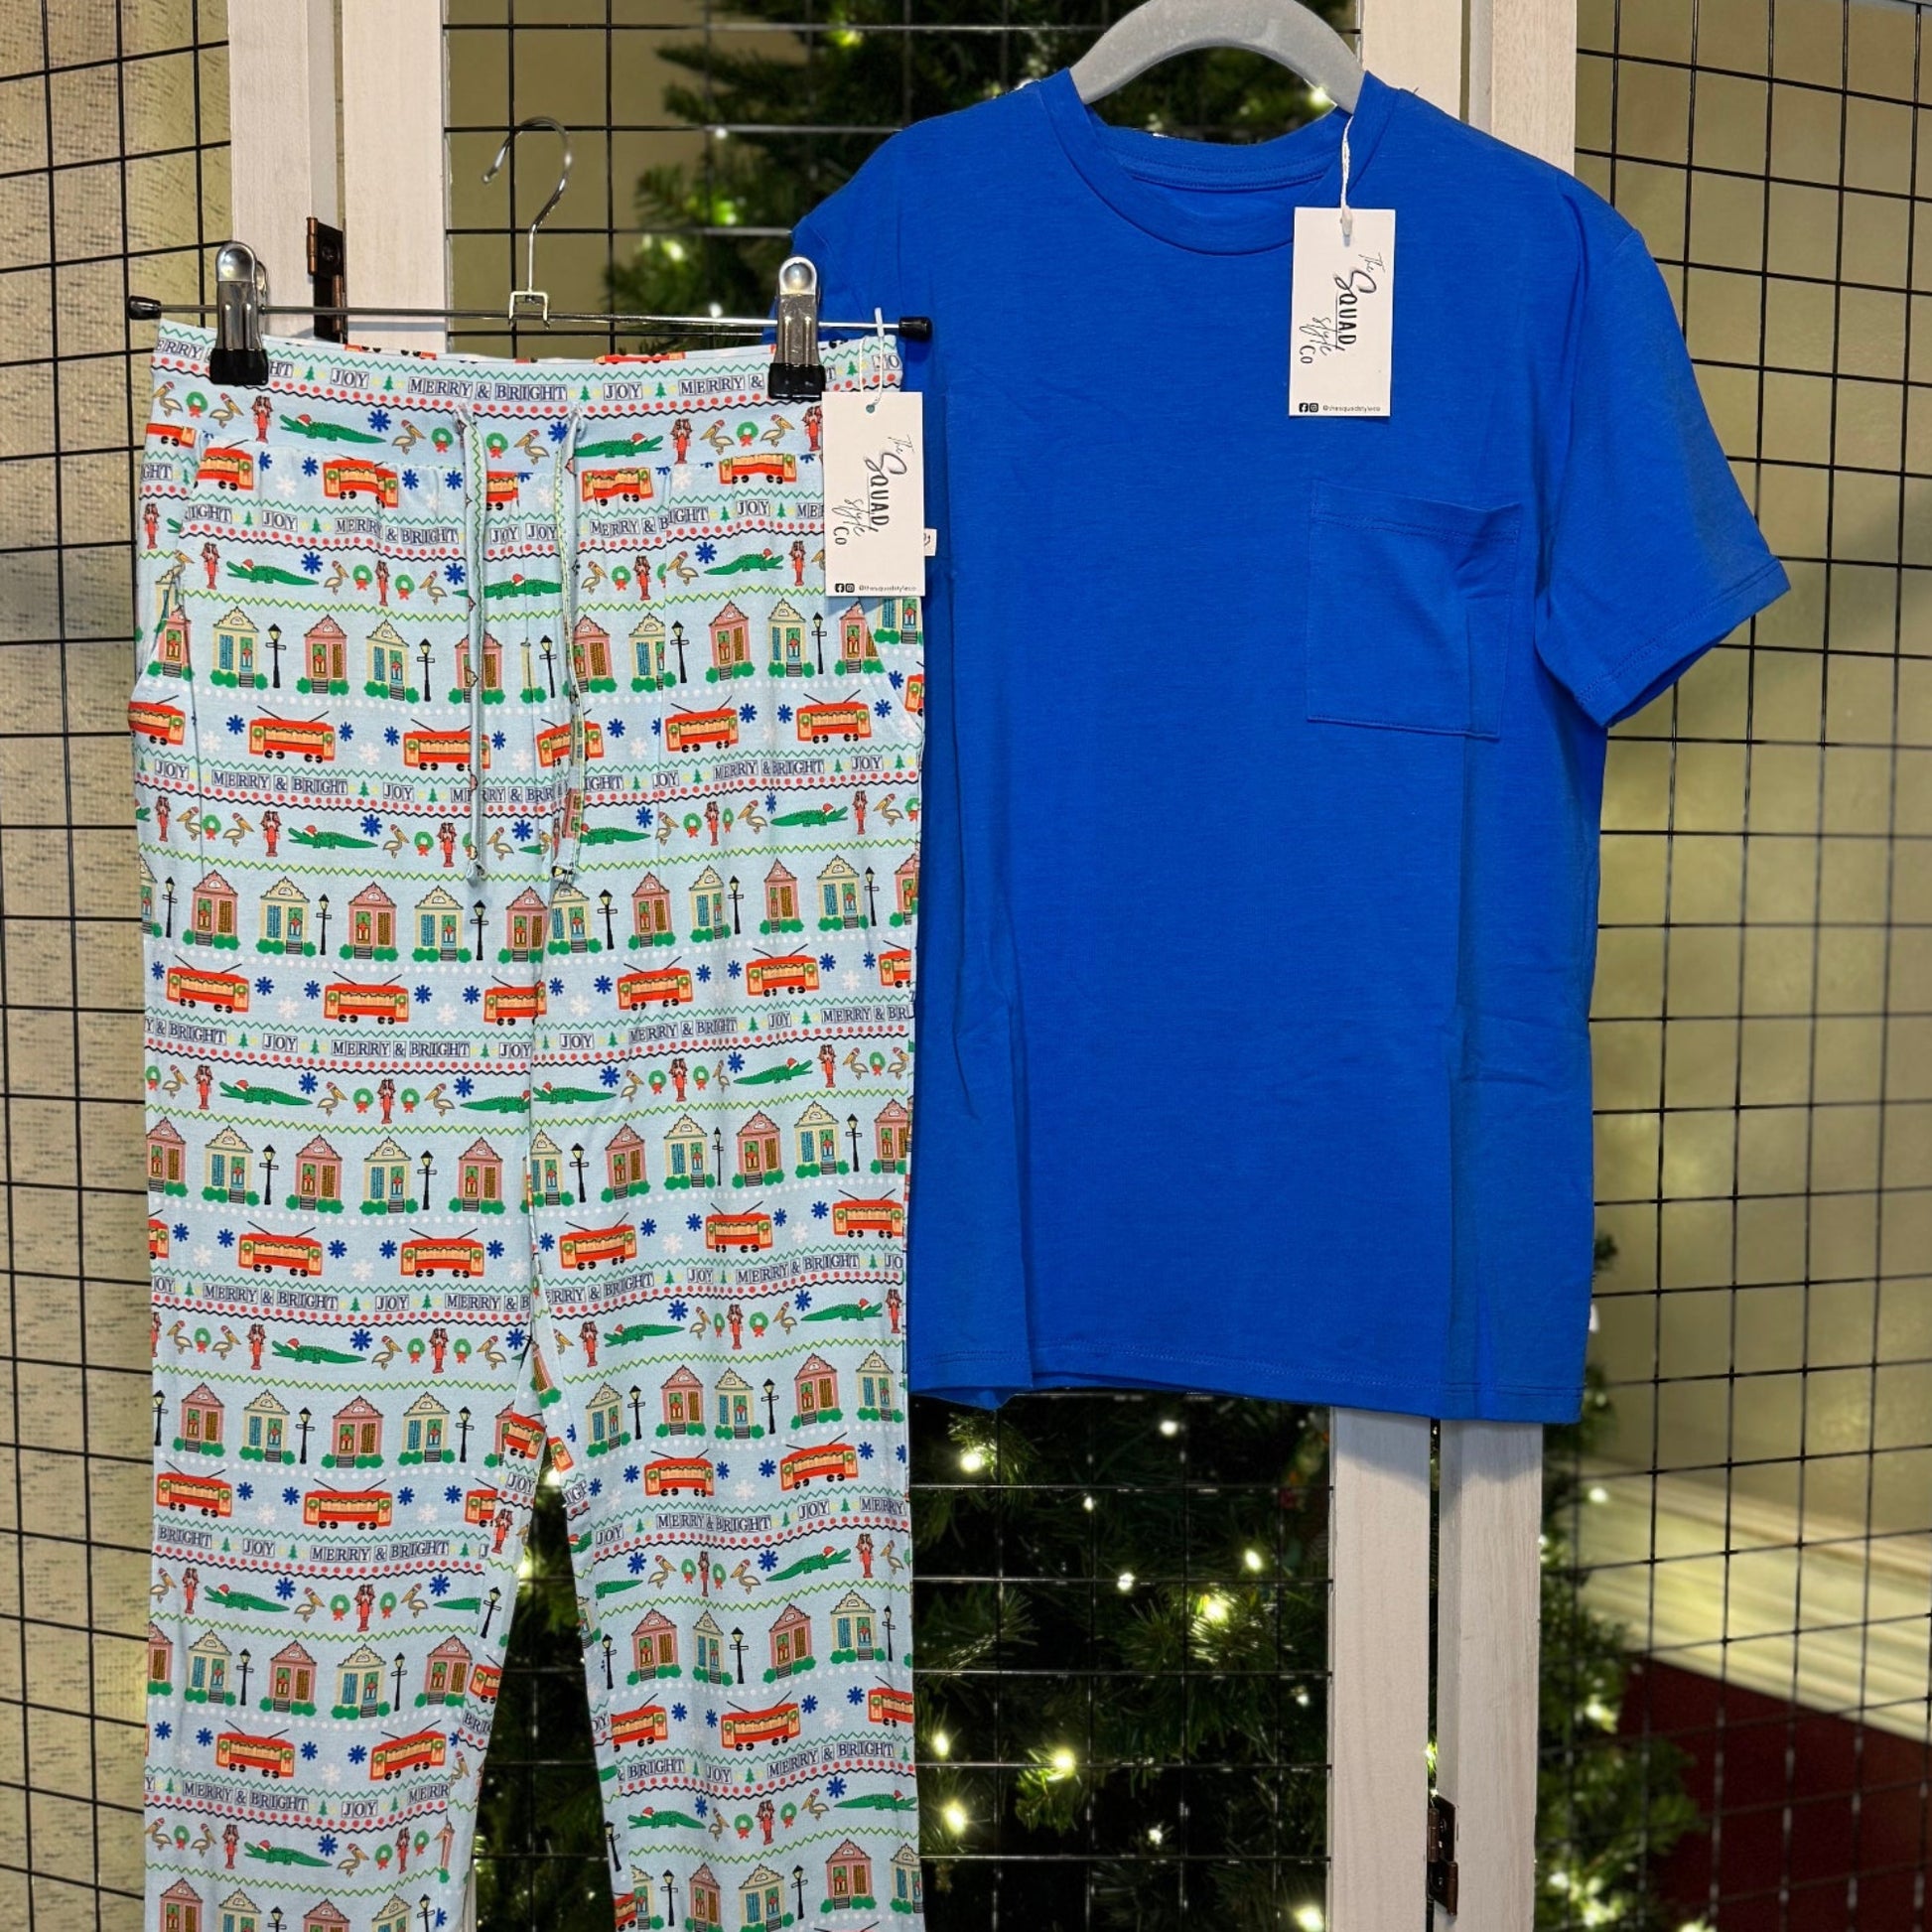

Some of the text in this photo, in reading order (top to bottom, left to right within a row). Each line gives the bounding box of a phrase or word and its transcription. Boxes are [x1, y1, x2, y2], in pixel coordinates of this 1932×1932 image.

[1358, 252, 1386, 272] The
[1299, 345, 1315, 364] Co
[332, 369, 368, 388] JOY
[679, 373, 763, 395] MERRY &
[409, 378, 567, 401] MERRY & BRIGHT
[605, 383, 642, 400] JOY
[888, 434, 914, 454] The
[737, 498, 770, 515] JOY
[263, 511, 297, 531] JOY
[642, 518, 655, 533] &
[385, 526, 398, 542] &
[833, 526, 848, 546] Co
[155, 760, 189, 780] JOY
[714, 759, 758, 780] MERRY
[851, 755, 883, 771] JOY
[211, 770, 347, 795] MERRY & BRIGHT
[383, 784, 414, 801] JOY
[508, 785, 522, 802] &
[767, 1012, 791, 1029] JOY
[822, 1006, 872, 1024] MERRY
[873, 1006, 885, 1021] &
[155, 1022, 166, 1037] &
[169, 1023, 226, 1044] BRIGHT
[681, 1021, 693, 1036] &
[263, 1035, 297, 1052] JOY
[331, 1039, 470, 1058] MERRY & BRIGHT
[498, 1042, 531, 1058] JOY
[560, 1033, 594, 1050] JOY
[687, 1268, 712, 1284] JOY
[737, 1254, 859, 1284] MERRY & BRIGHT
[588, 1281, 601, 1300] &
[603, 1273, 654, 1299] BRIGHT
[203, 1284, 338, 1311] MERRY & BRIGHT
[375, 1294, 409, 1311] JOY
[445, 1293, 500, 1311] MERRY
[505, 1294, 517, 1310] &
[798, 1500, 830, 1518] JOY
[859, 1496, 907, 1515] MERRY
[658, 1513, 704, 1529] MERRY
[159, 1528, 211, 1549] BRIGHT
[596, 1525, 623, 1546] JOY
[243, 1539, 275, 1557] JOY
[310, 1541, 449, 1563] MERRY & BRIGHT
[627, 1758, 685, 1778] BRIGHT
[766, 1740, 894, 1778] MERRY & BRIGHT
[183, 1781, 309, 1812] MERRY & BRIGHT
[342, 1799, 377, 1817] JOY
